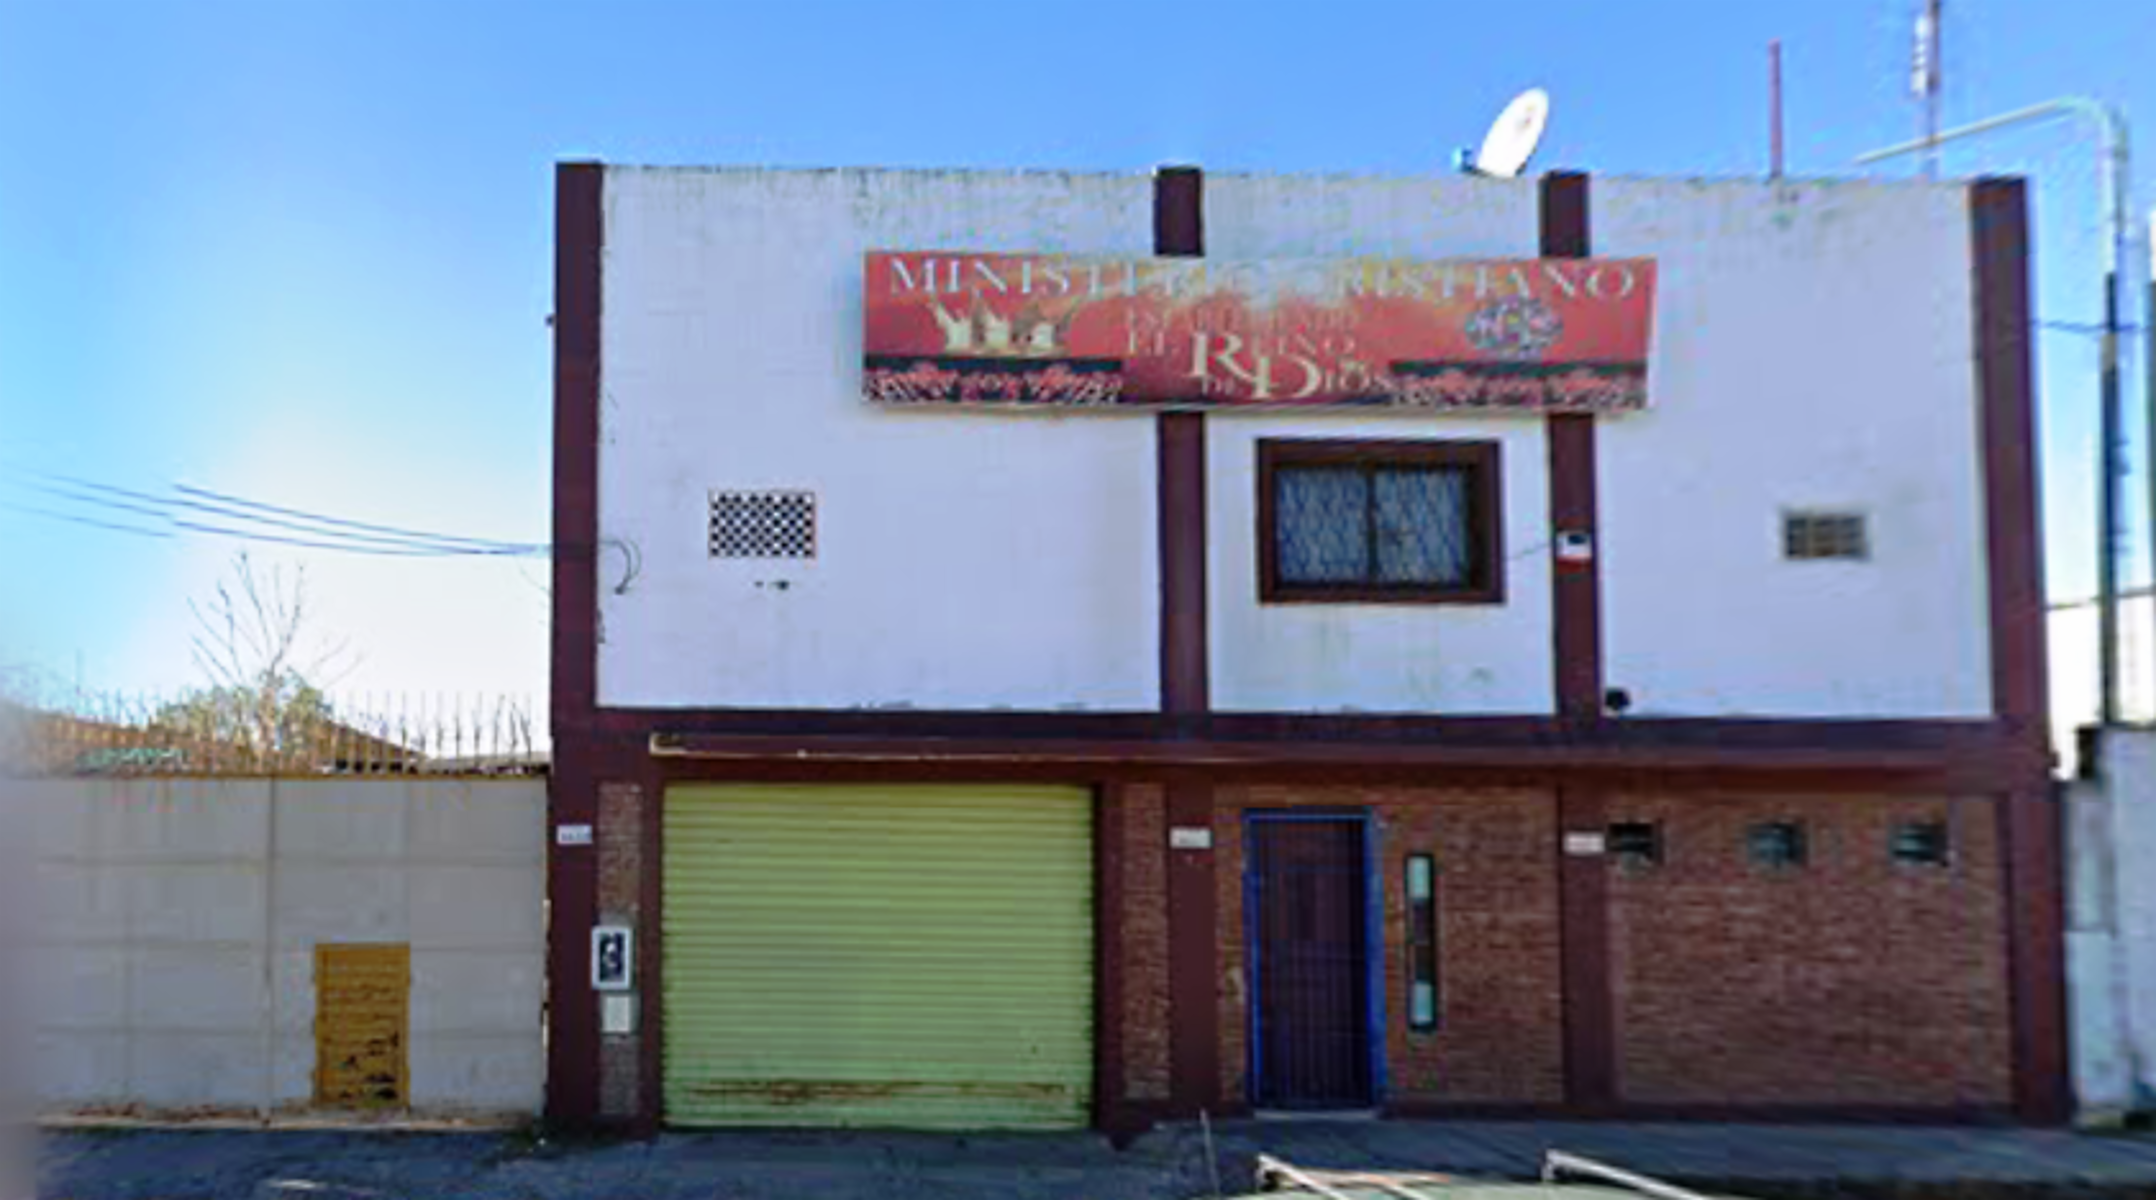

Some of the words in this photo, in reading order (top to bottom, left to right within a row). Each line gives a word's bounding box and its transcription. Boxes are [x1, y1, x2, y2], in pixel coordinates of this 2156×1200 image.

[889, 258, 1264, 297] MINISTERIO
[1287, 257, 1638, 298] CRISTIANO
[1124, 329, 1180, 357] EL
[1184, 331, 1357, 381] REINO
